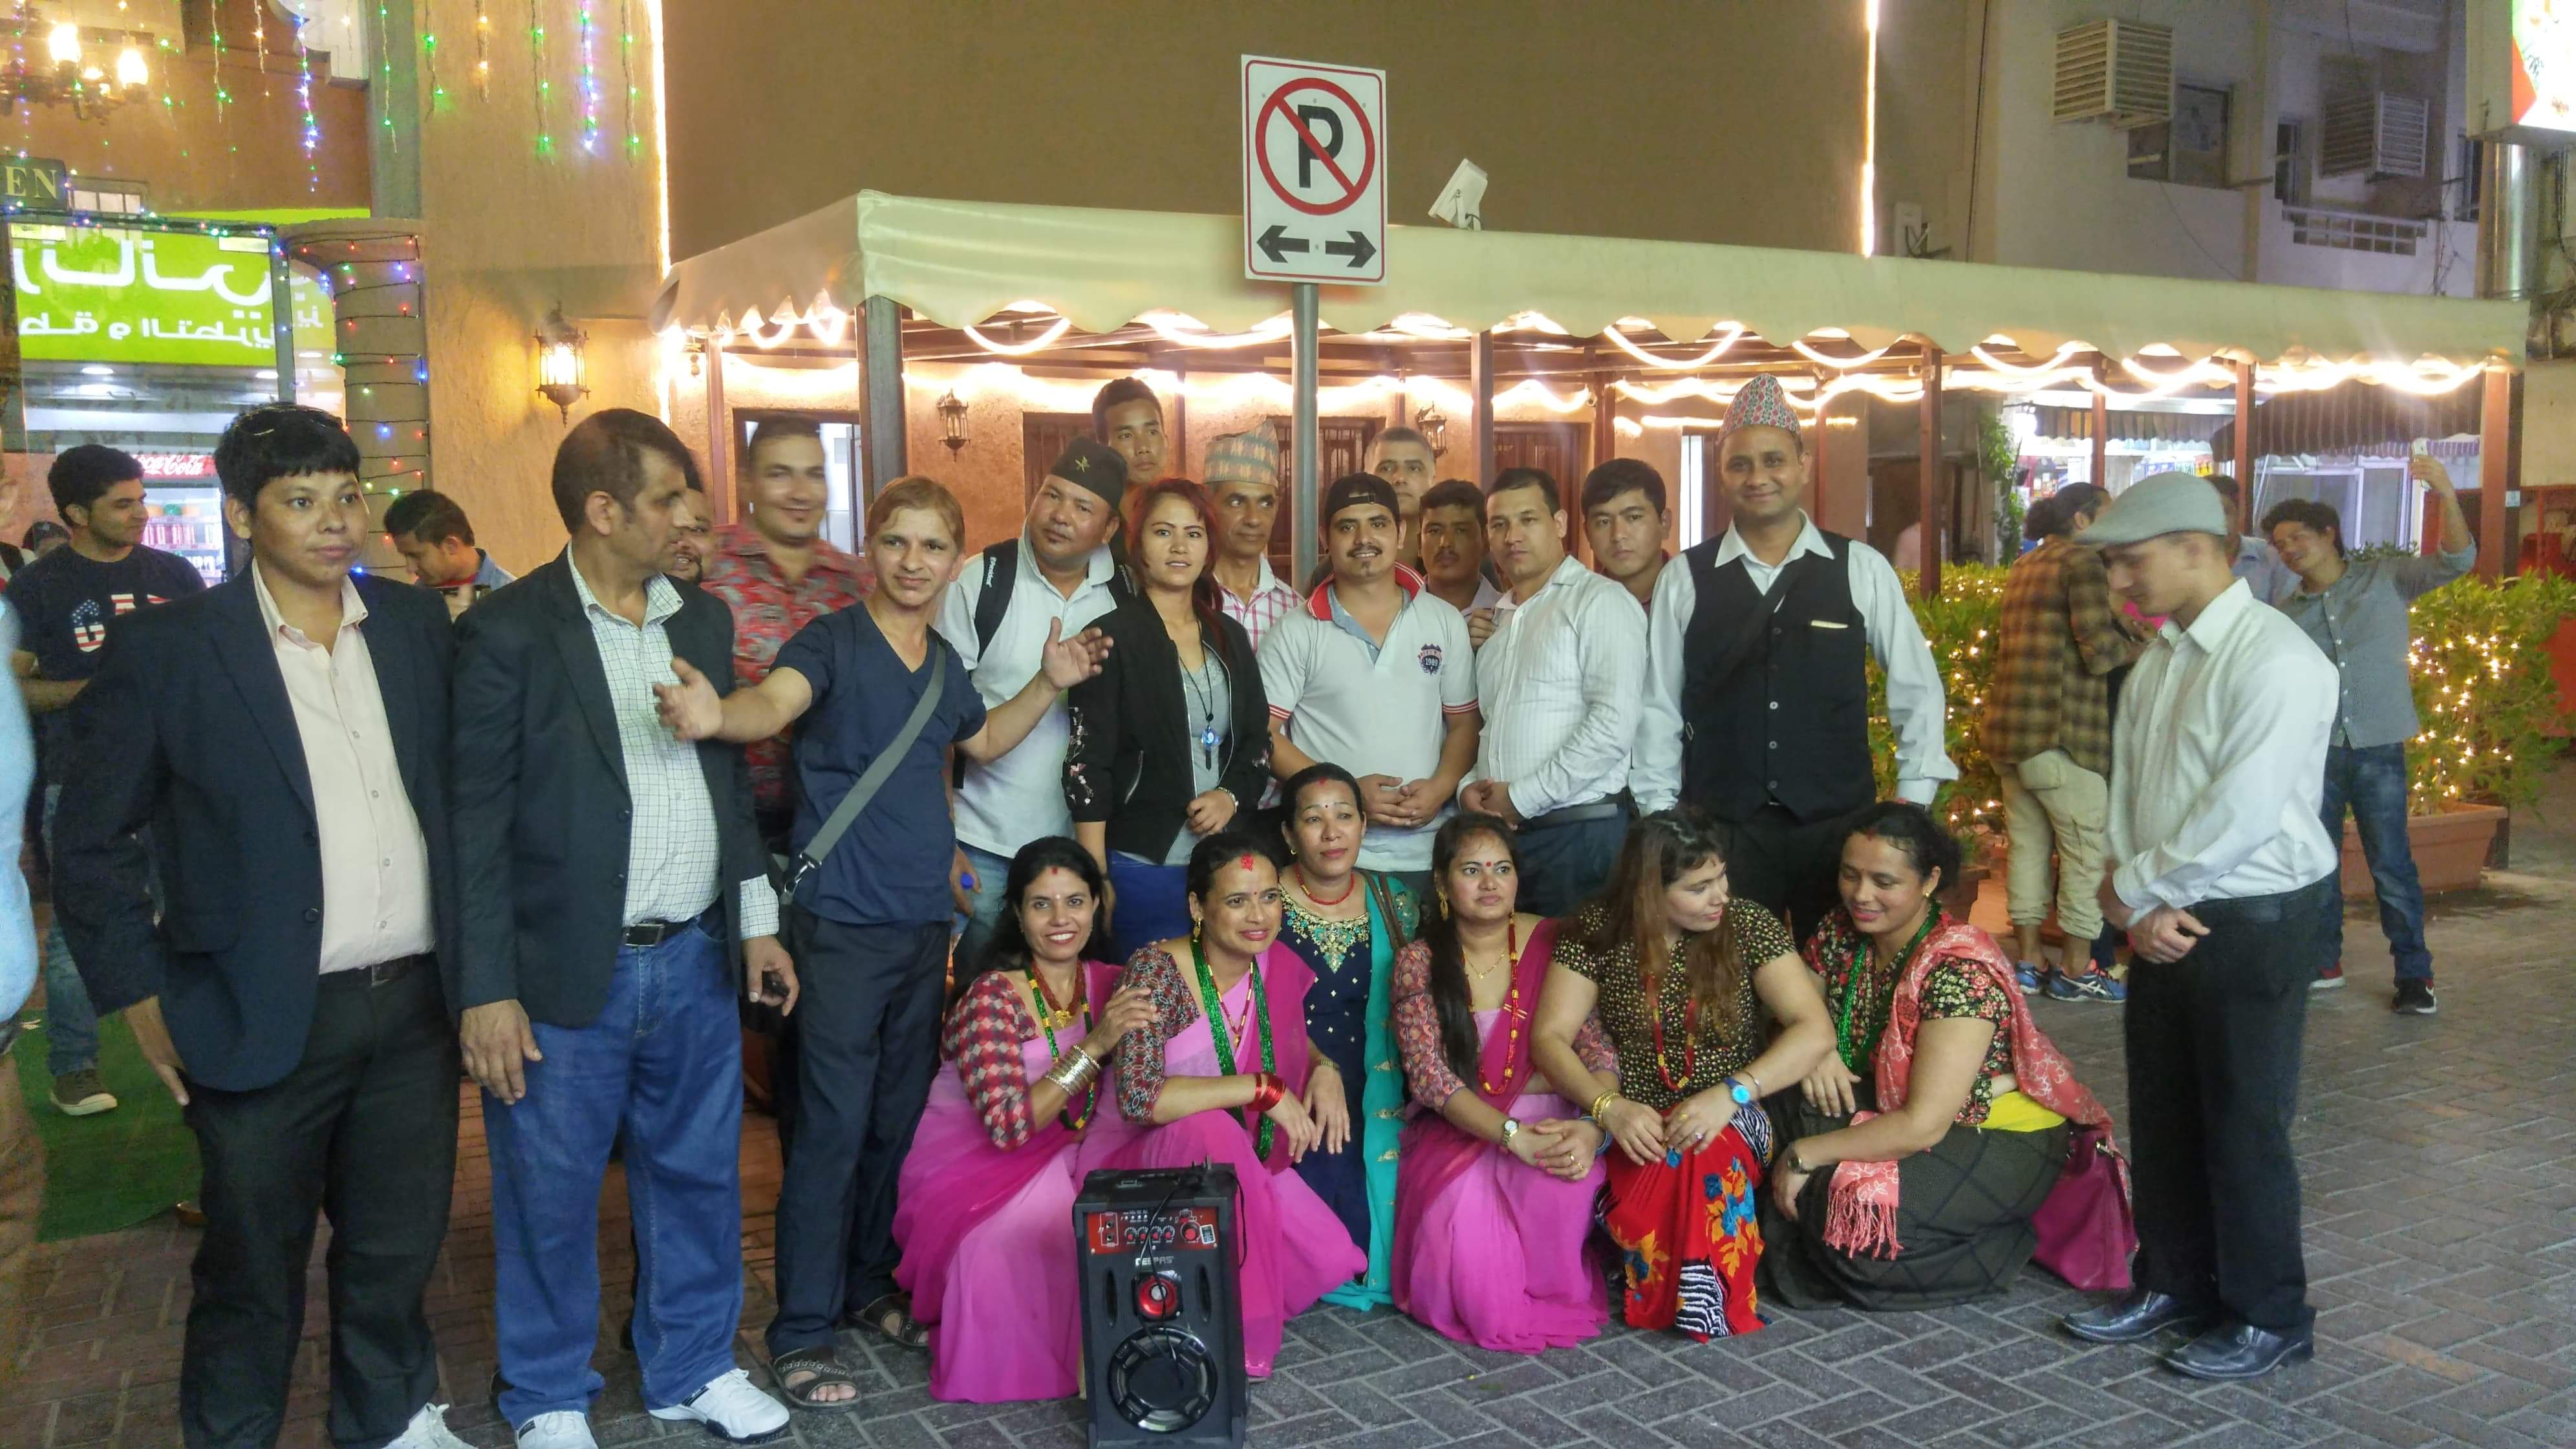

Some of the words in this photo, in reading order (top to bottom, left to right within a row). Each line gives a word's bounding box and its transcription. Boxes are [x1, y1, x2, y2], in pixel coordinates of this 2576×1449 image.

[1298, 104, 1344, 189] P
[4, 166, 57, 199] EN
[1425, 657, 1438, 667] 1989
